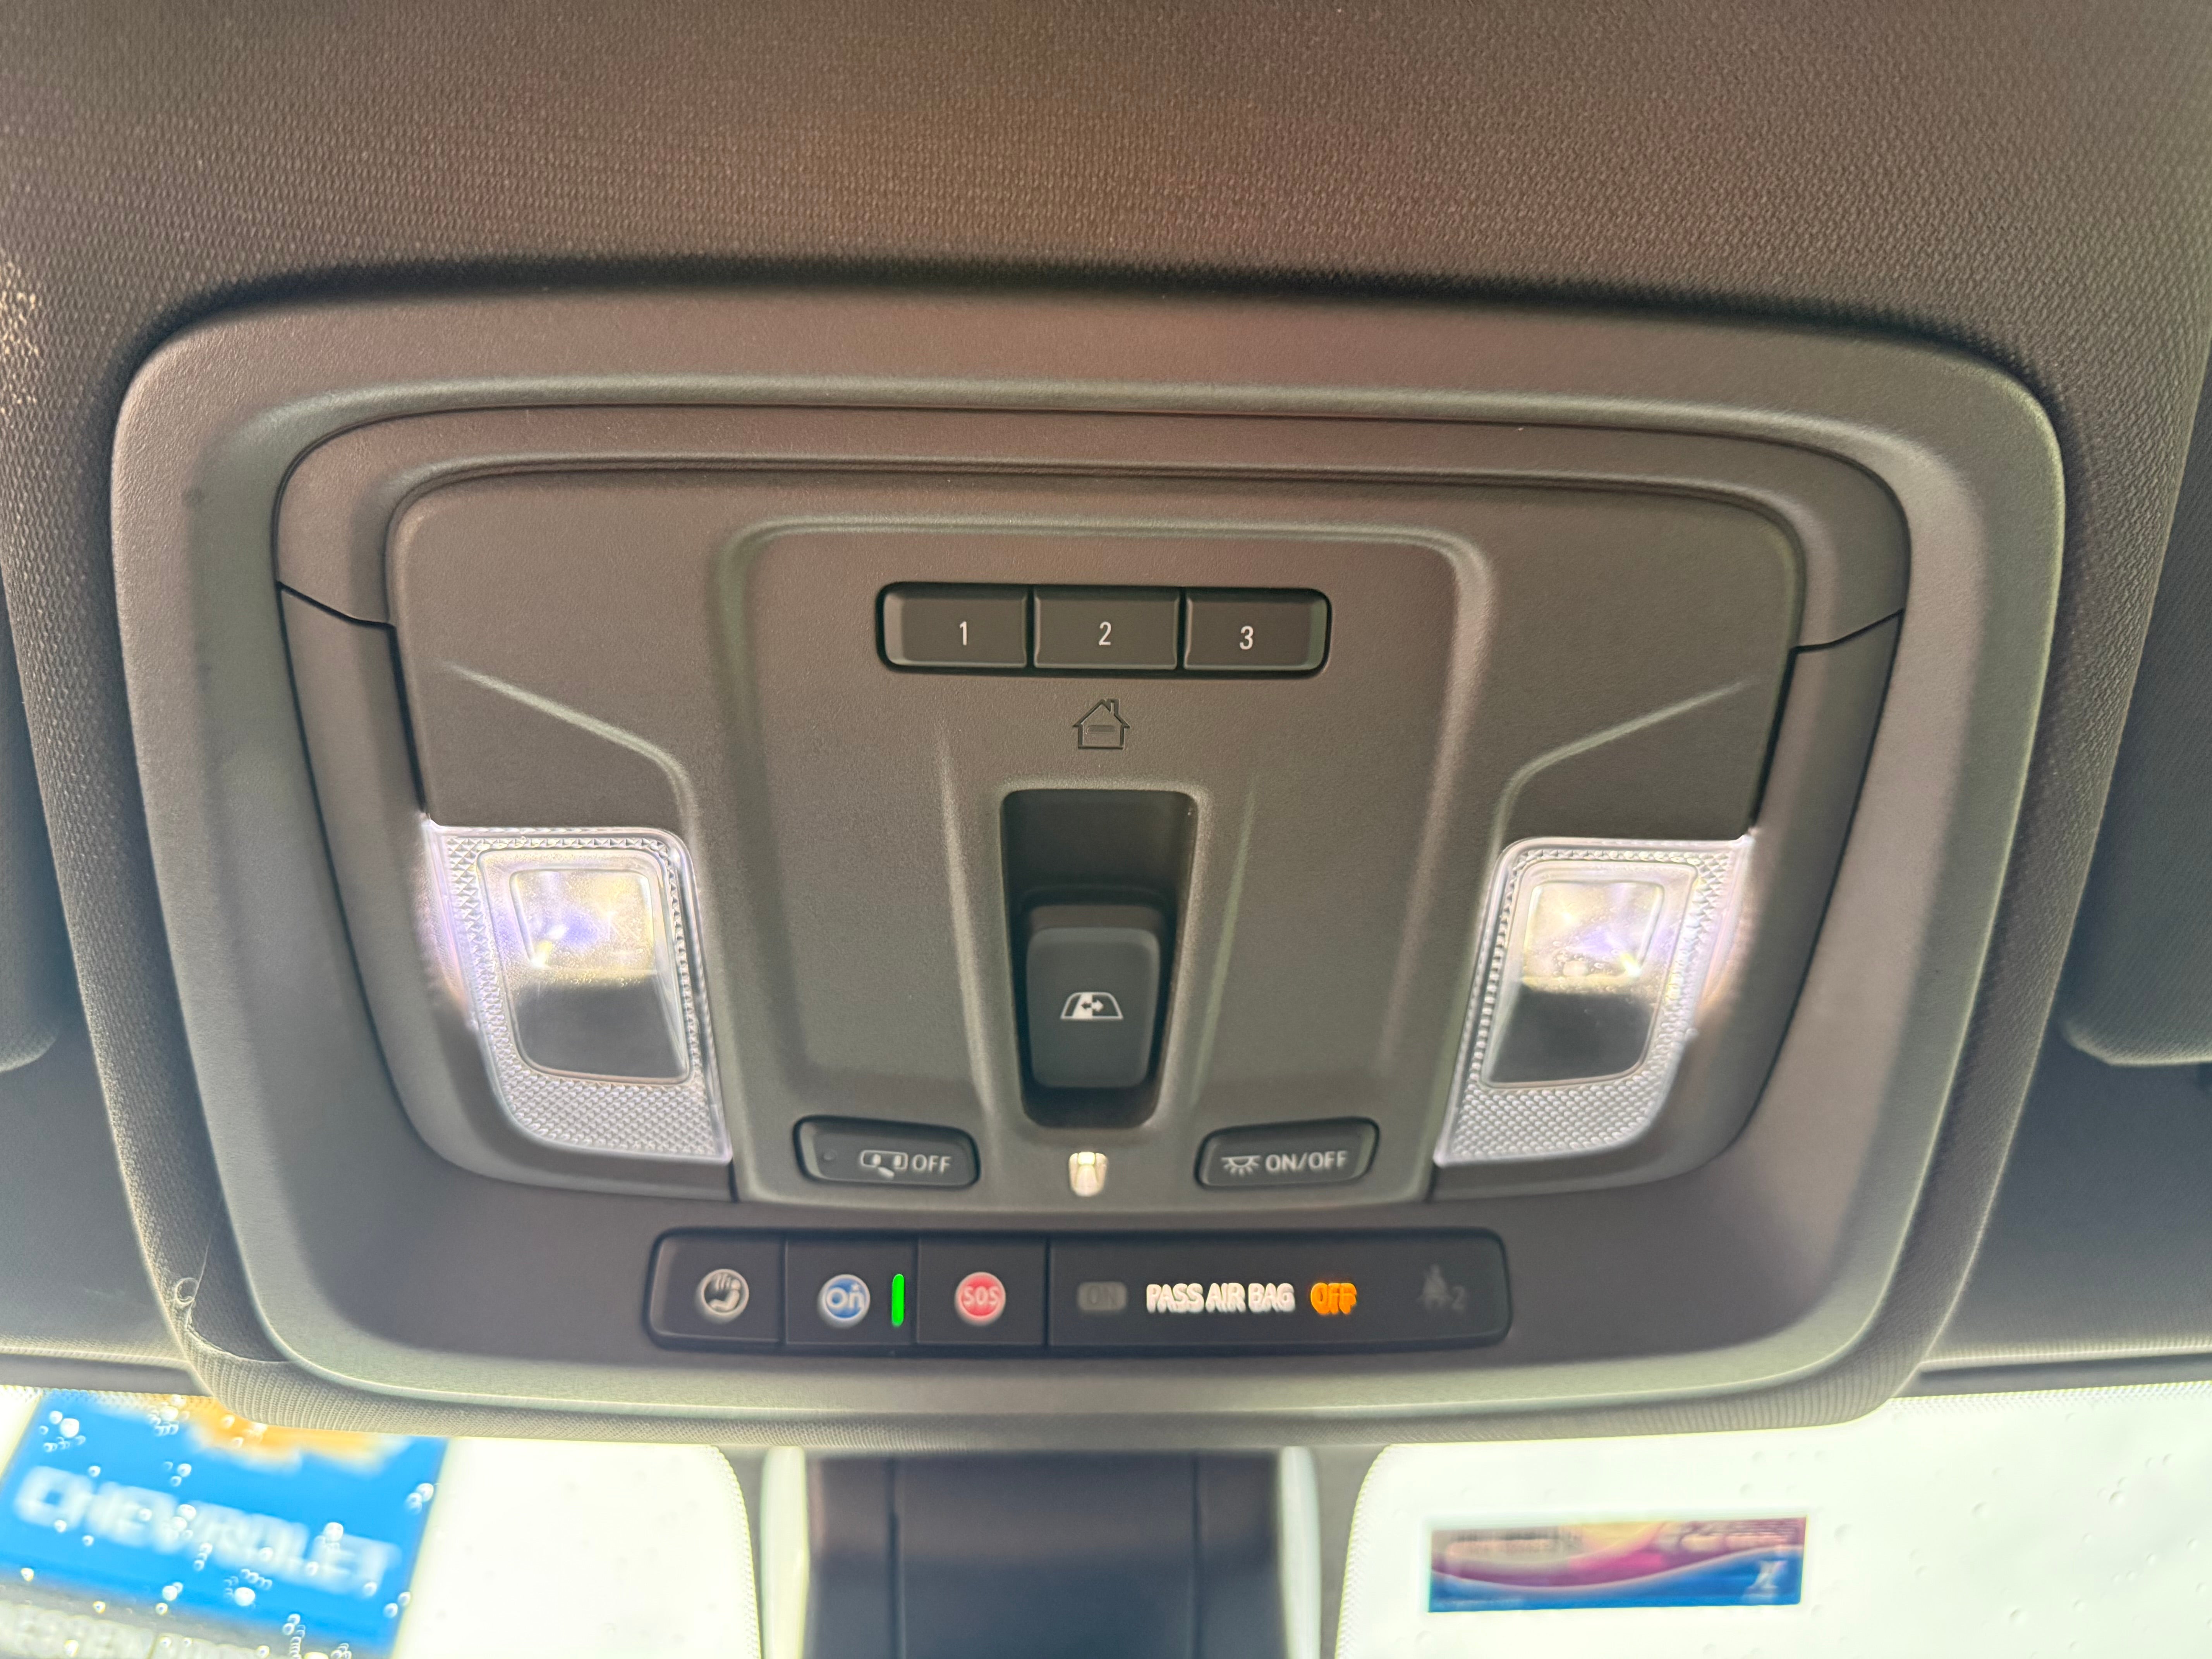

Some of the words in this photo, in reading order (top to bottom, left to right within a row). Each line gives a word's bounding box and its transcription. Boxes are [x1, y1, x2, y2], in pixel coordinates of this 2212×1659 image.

[960, 621, 969, 646] 1
[1099, 622, 1112, 646] 2
[1240, 626, 1254, 650] 3
[912, 1154, 951, 1173] OFF
[1265, 1150, 1347, 1172] ON/OFF
[963, 1285, 1000, 1307] SOS
[1146, 1283, 1204, 1313] PASS
[1205, 1283, 1247, 1313] AIR
[1248, 1283, 1295, 1313] BAG
[1310, 1282, 1357, 1314] OFF
